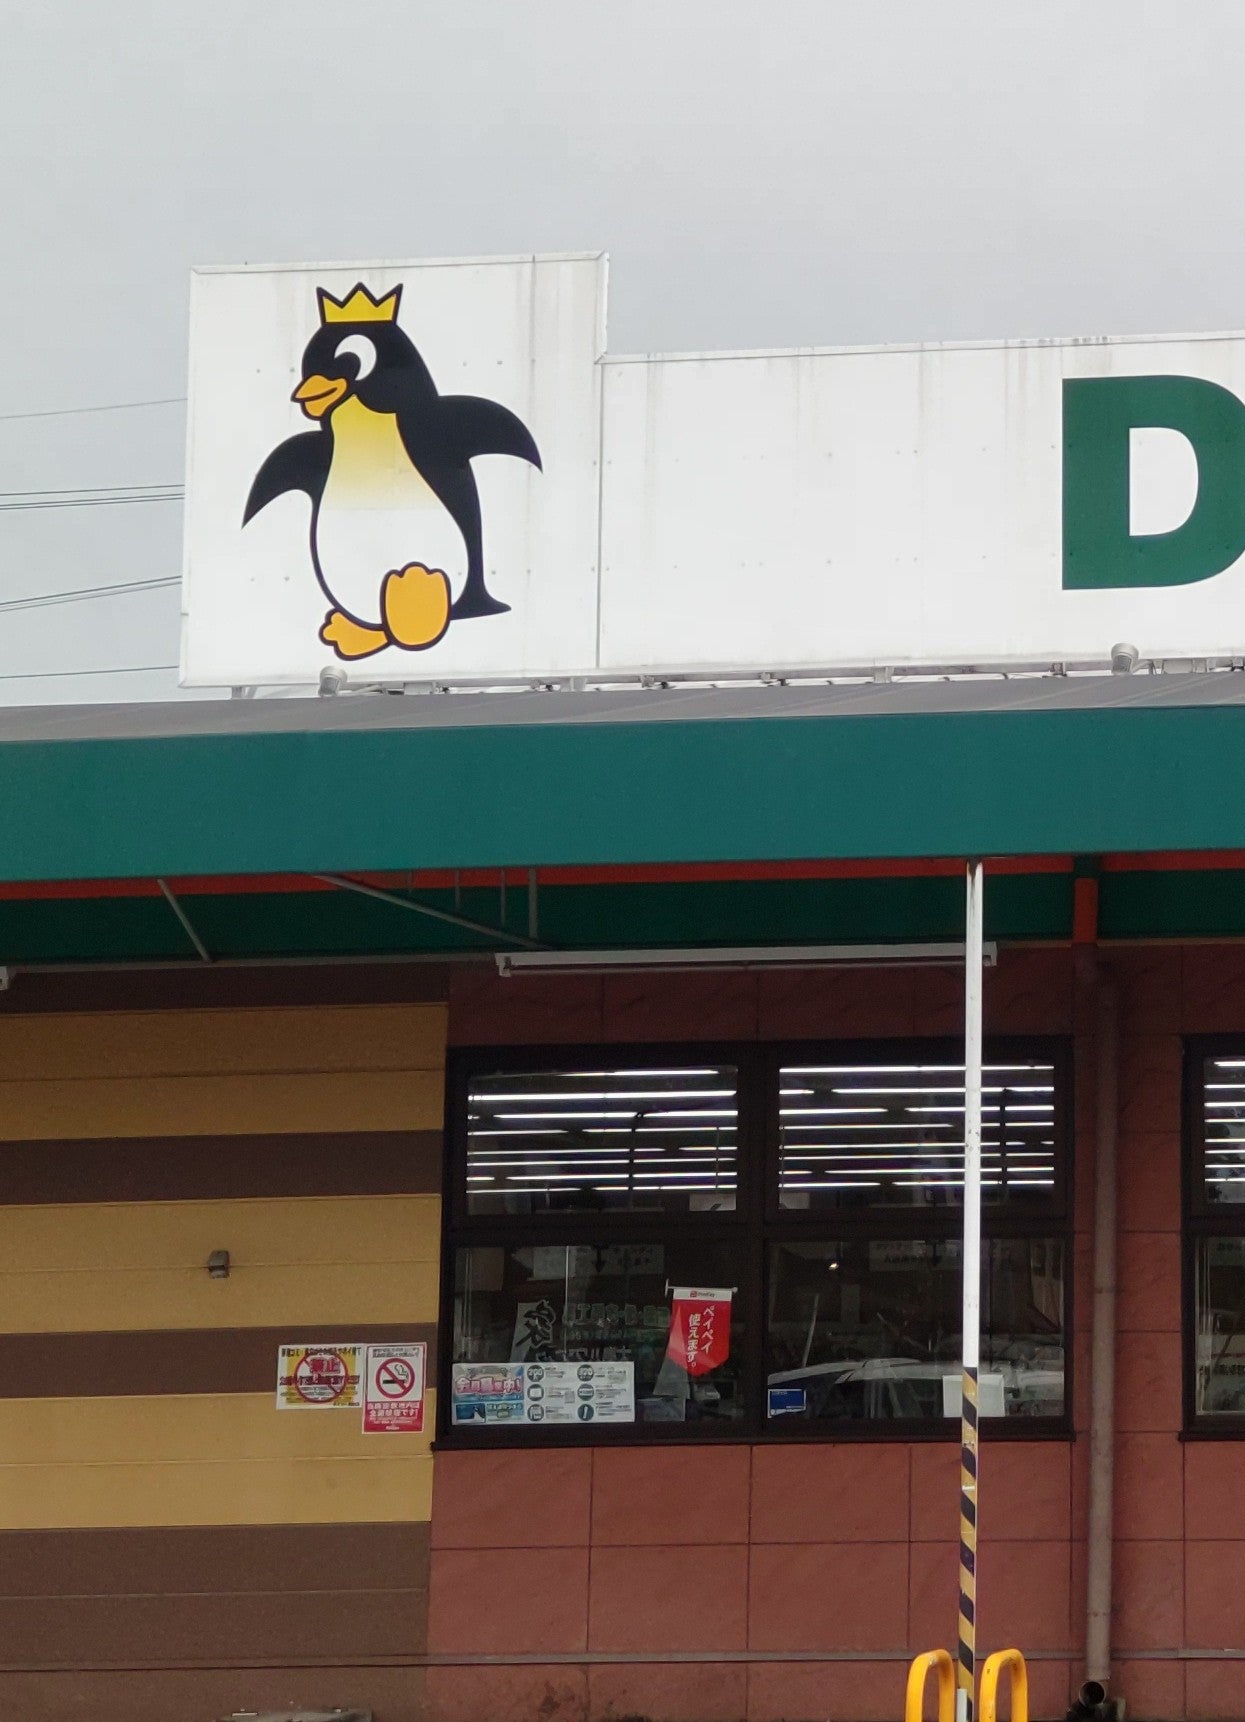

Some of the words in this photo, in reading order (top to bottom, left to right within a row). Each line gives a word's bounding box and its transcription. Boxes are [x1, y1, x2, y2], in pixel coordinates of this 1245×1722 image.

[687, 1313, 702, 1367] 使えます。
[701, 1305, 715, 1354] ペイペイ
